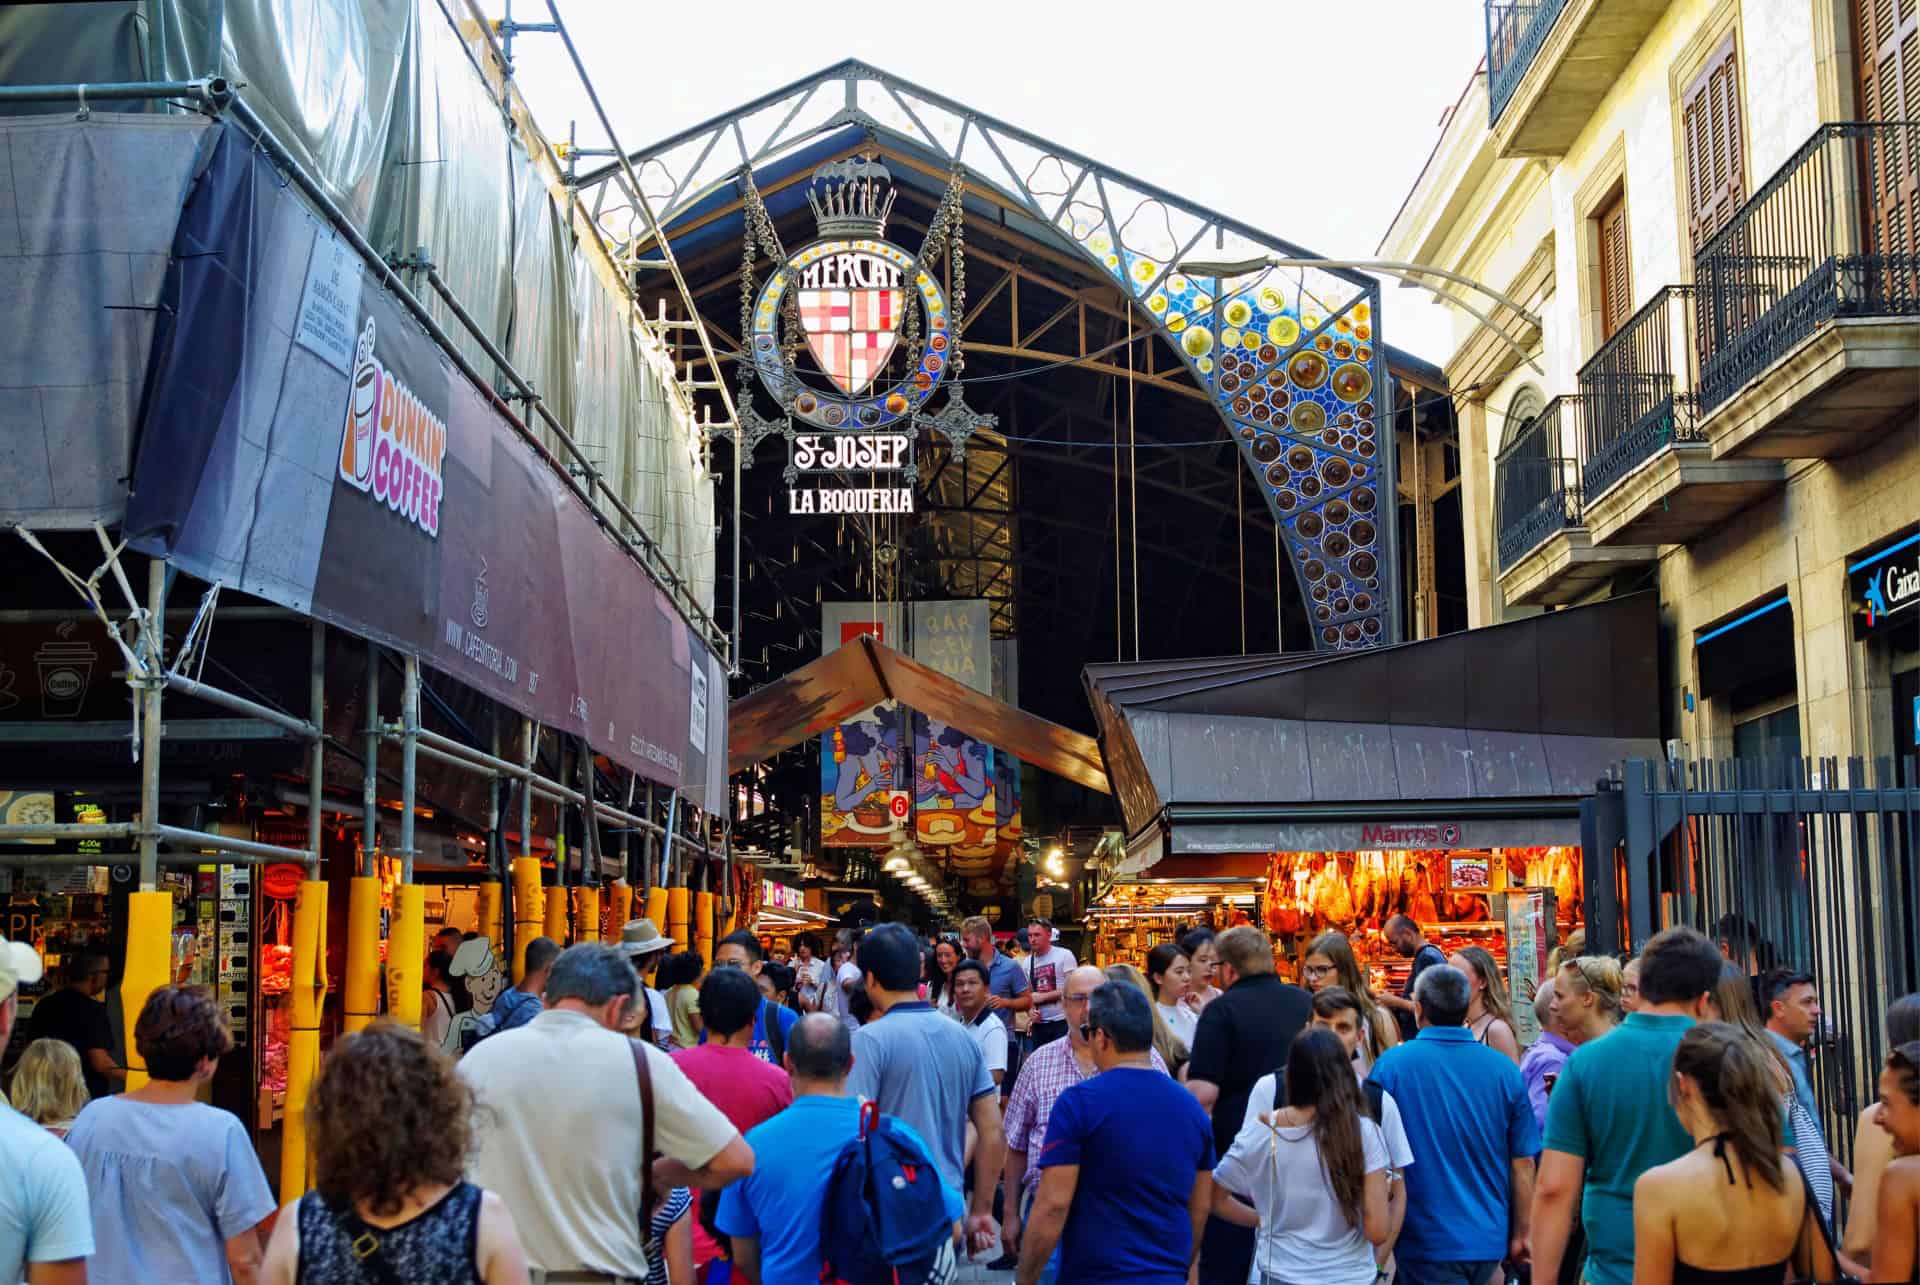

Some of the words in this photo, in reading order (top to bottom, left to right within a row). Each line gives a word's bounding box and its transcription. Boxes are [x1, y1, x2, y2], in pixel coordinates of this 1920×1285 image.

[803, 254, 901, 288] MERCAT
[381, 377, 446, 474] DUNKIN'
[821, 436, 909, 469] JOSEP
[375, 438, 440, 530] COFFEE
[790, 488, 815, 514] LA
[820, 488, 914, 513] BOQUERIA
[1887, 555, 1920, 602] Caixa
[896, 800, 903, 814] 6
[1362, 824, 1439, 843] Marcos
